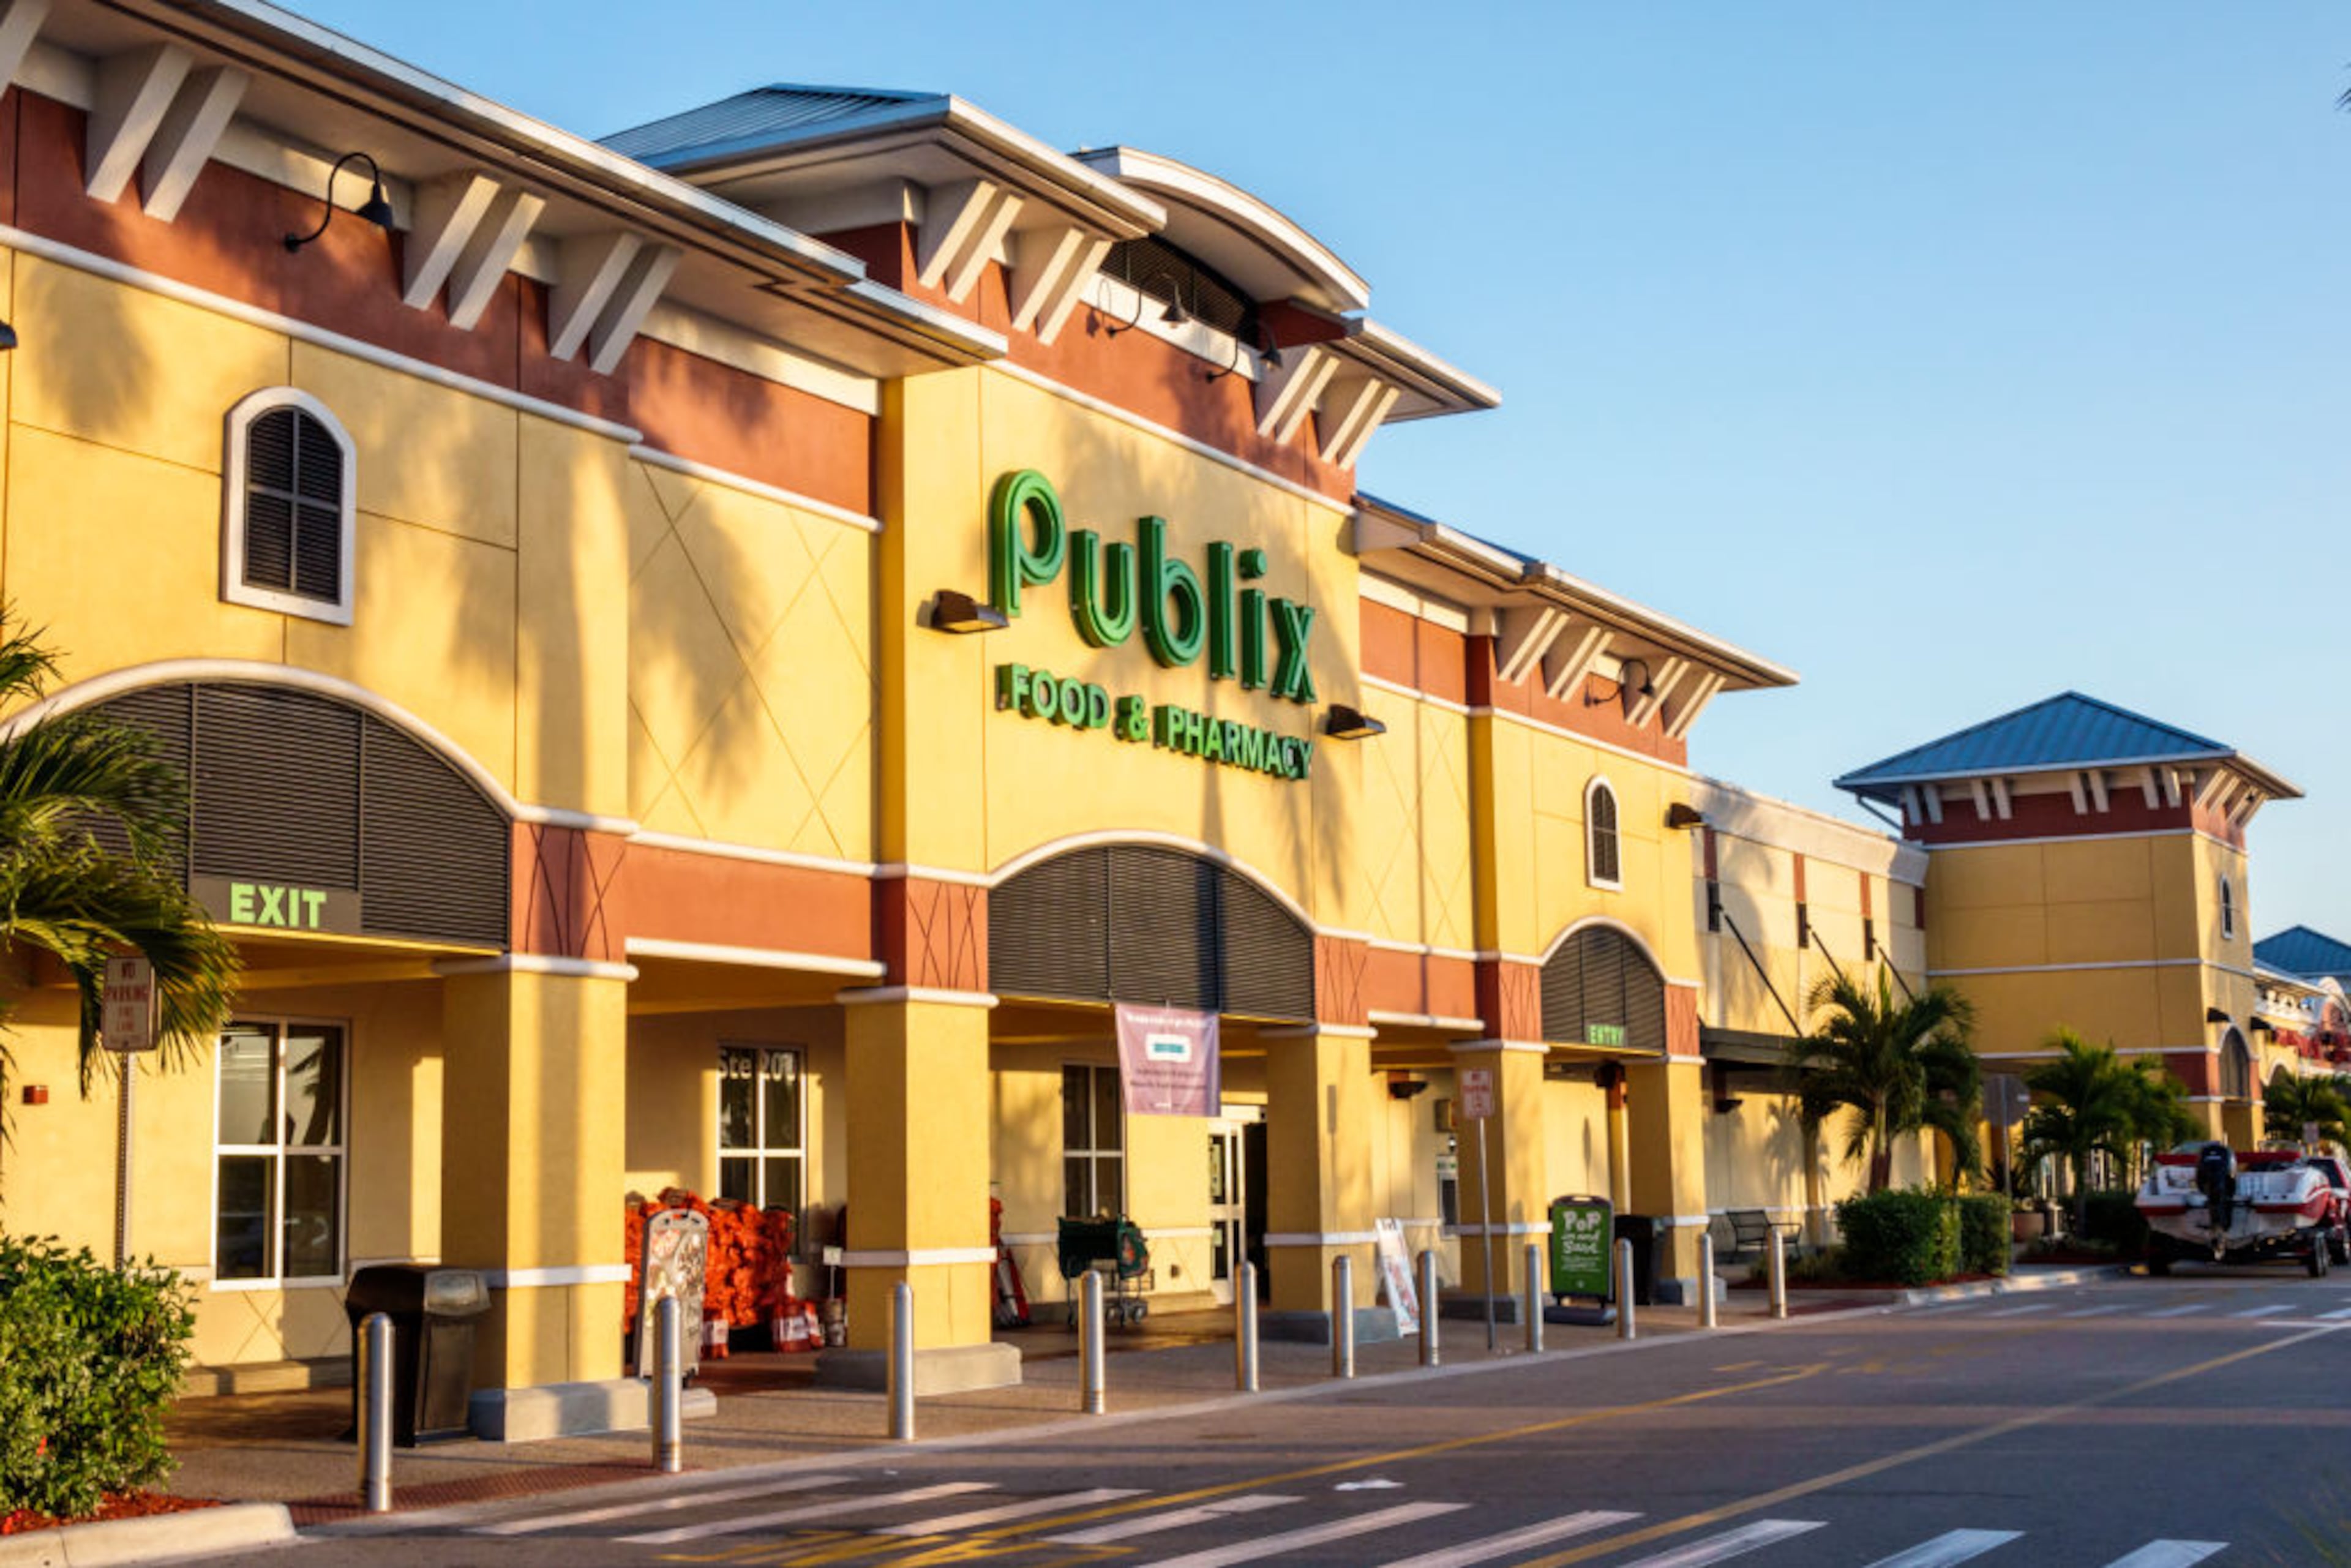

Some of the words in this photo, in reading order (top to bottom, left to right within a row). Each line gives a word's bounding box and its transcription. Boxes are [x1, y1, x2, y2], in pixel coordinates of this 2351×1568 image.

[989, 470, 1316, 702] Publix
[997, 664, 1109, 729] FOOD
[1116, 695, 1149, 741] &
[1153, 705, 1313, 779] PHARMACY
[230, 882, 327, 929] EXIT
